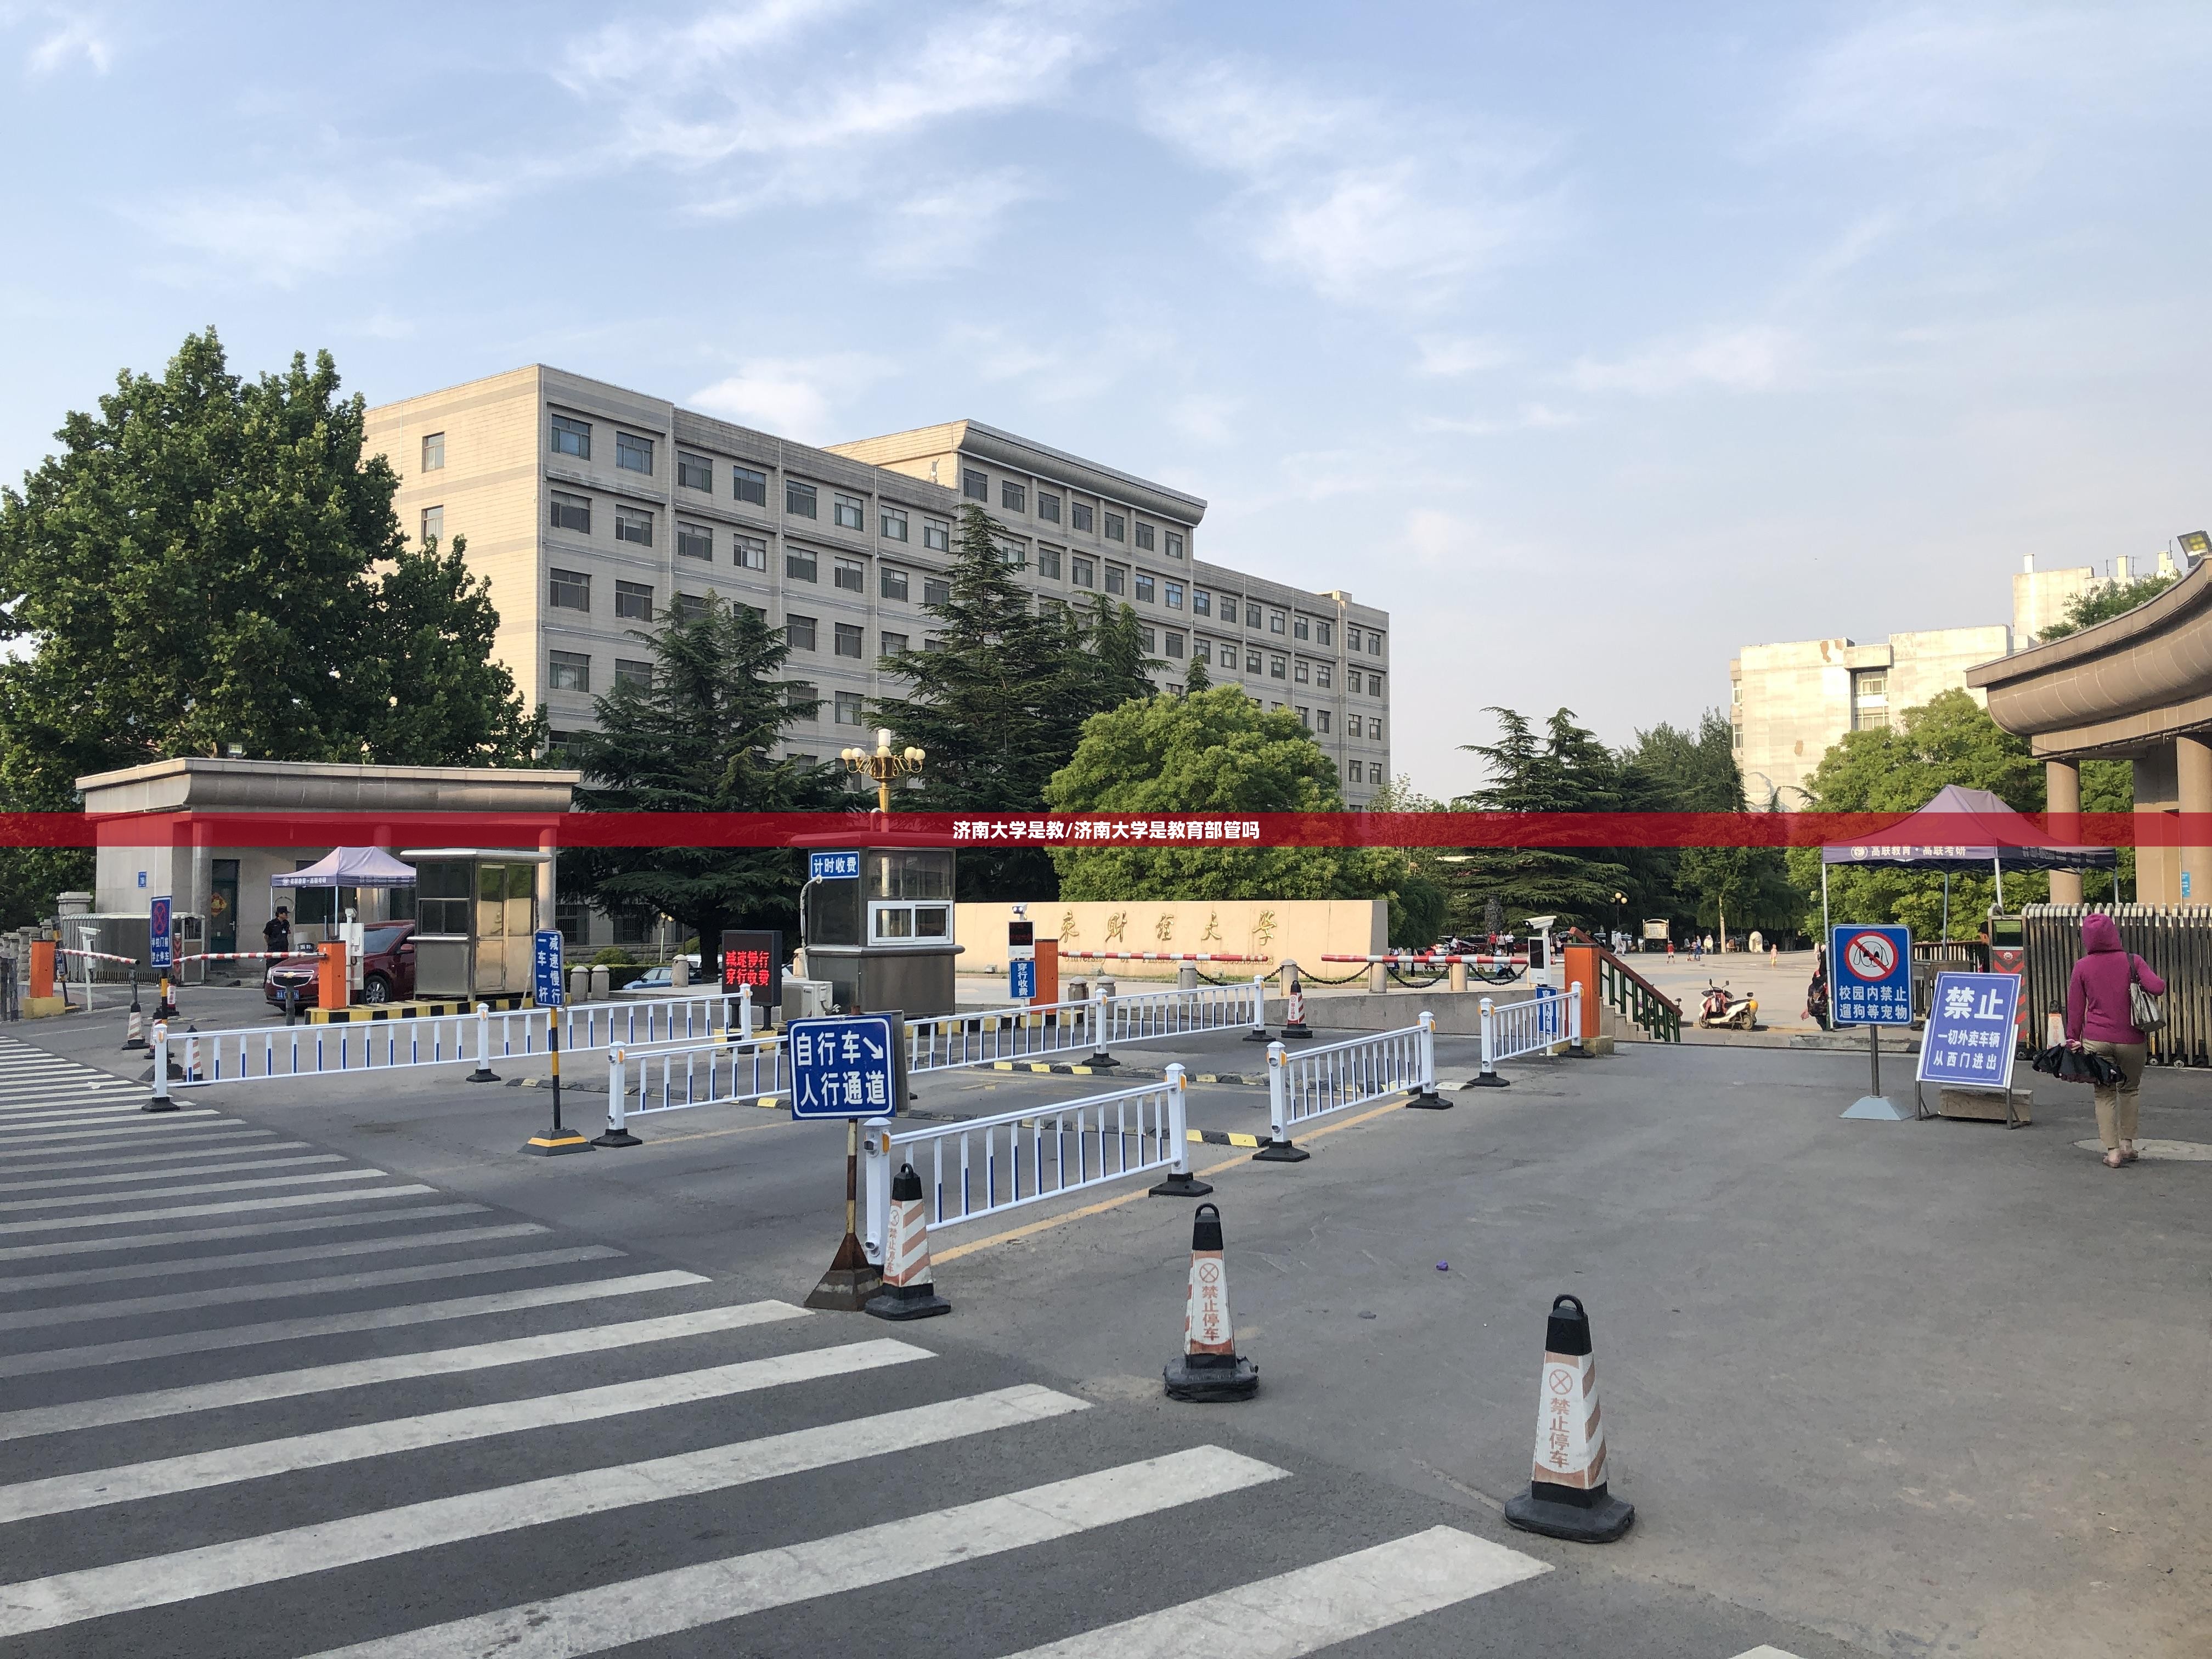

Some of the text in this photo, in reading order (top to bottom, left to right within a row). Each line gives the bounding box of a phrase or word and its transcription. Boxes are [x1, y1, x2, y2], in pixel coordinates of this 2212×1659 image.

[814, 856, 856, 874] 计时收费
[537, 939, 548, 1002] 一车一杆
[549, 935, 561, 1004] 减速慢行
[1018, 963, 1028, 996] 穿行收费
[1839, 985, 1907, 1002] 校园内禁止
[1943, 986, 2004, 1020] 禁止
[1839, 1003, 1908, 1020] 遛狗等宠物
[797, 1030, 861, 1066] 自行车
[1937, 1029, 2001, 1048] 一切外卖车辆
[1933, 1050, 1997, 1070] 从西门进出
[800, 1070, 886, 1107] 人行通道
[1202, 1285, 1220, 1341] 禁止停车
[1549, 1397, 1570, 1468] 禁止停车
